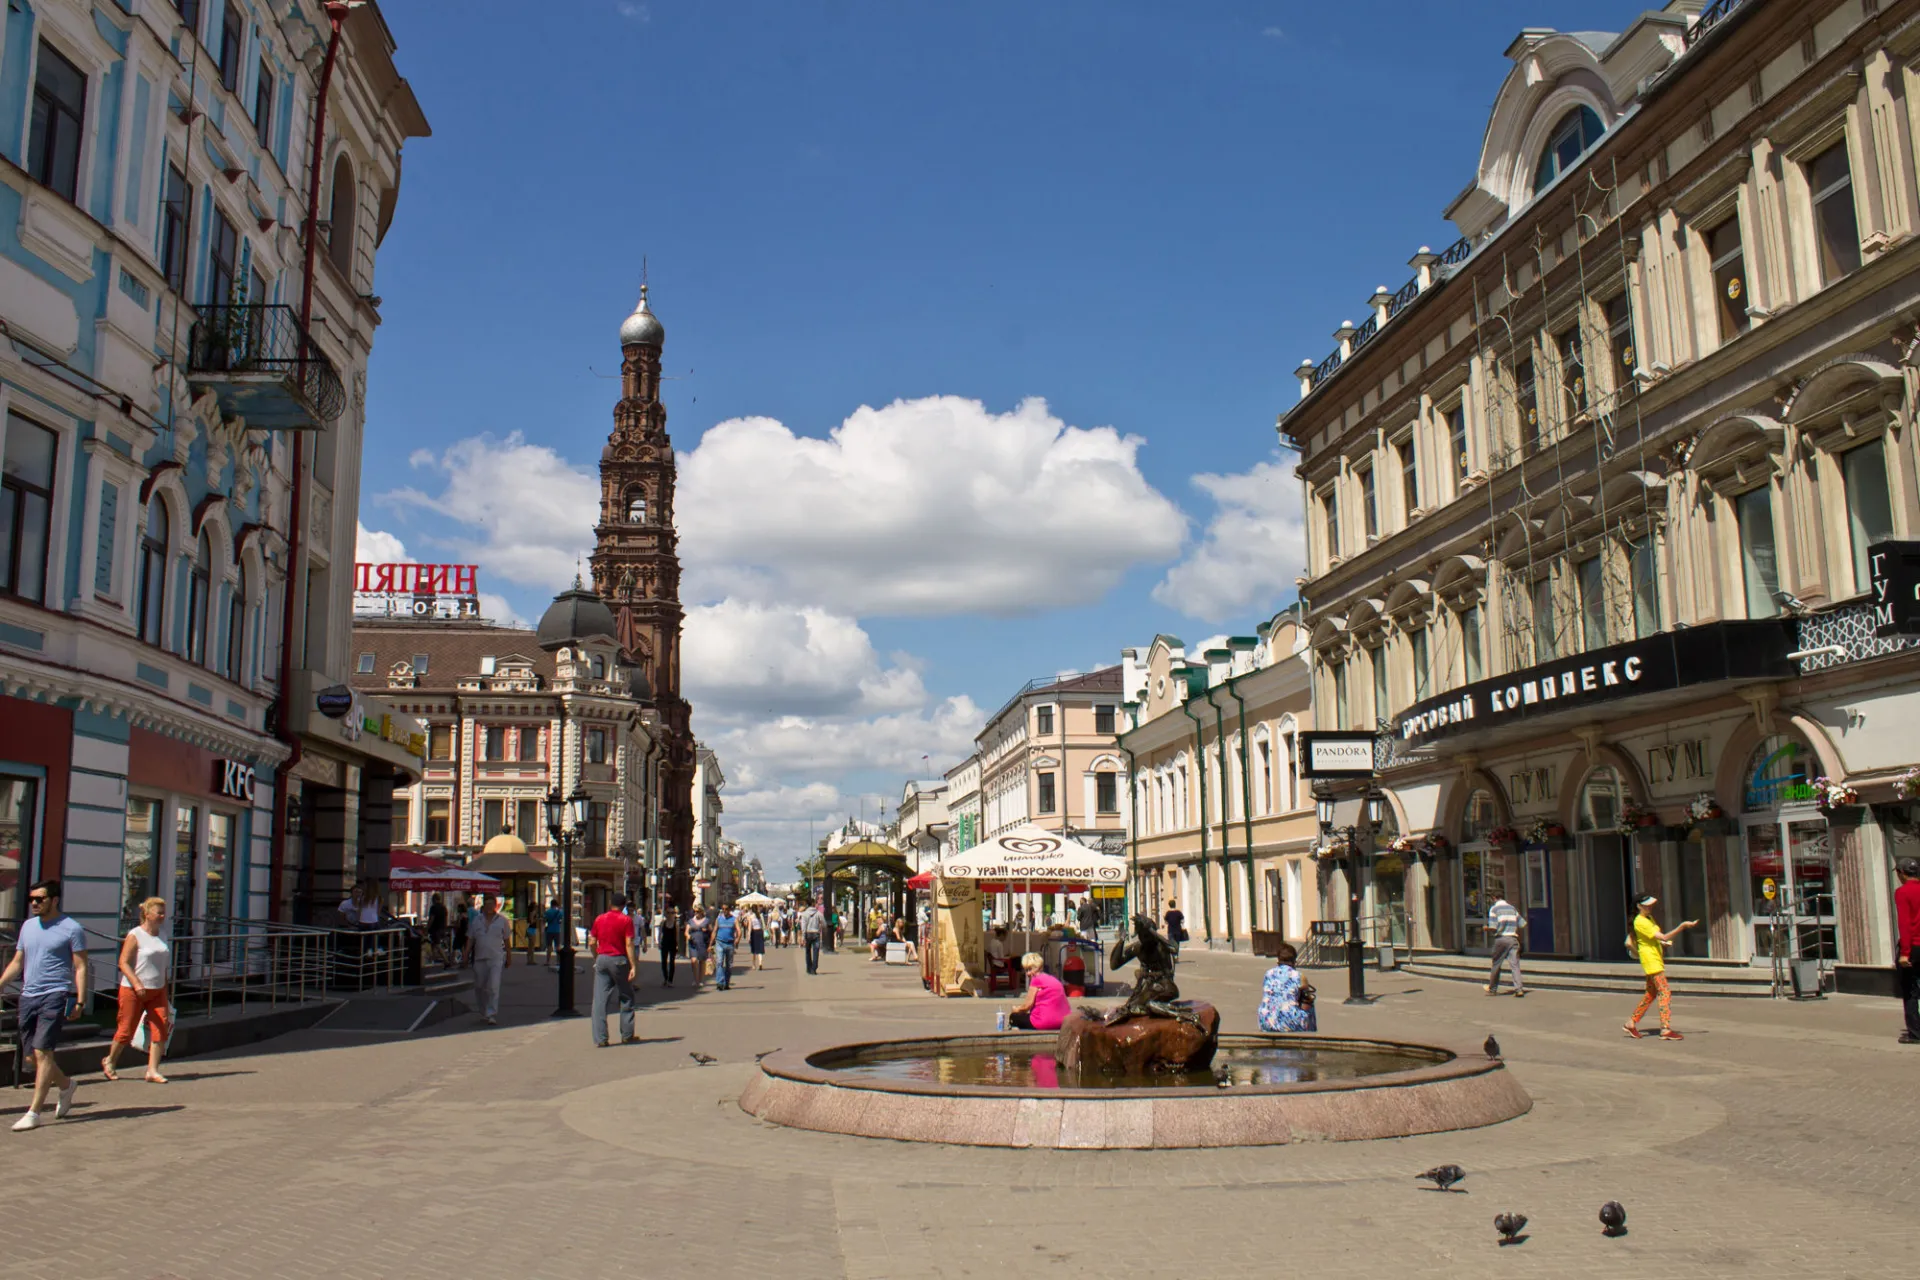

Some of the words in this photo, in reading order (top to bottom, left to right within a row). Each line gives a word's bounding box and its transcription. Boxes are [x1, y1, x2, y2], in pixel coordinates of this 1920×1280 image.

[1872, 553, 1895, 627] ГУМ
[1402, 694, 1475, 740] ТОРГОВЫЙ
[1491, 656, 1643, 712] КОМПЛЕКС
[223, 760, 255, 801] KFC
[1646, 739, 1709, 785] ГУМ
